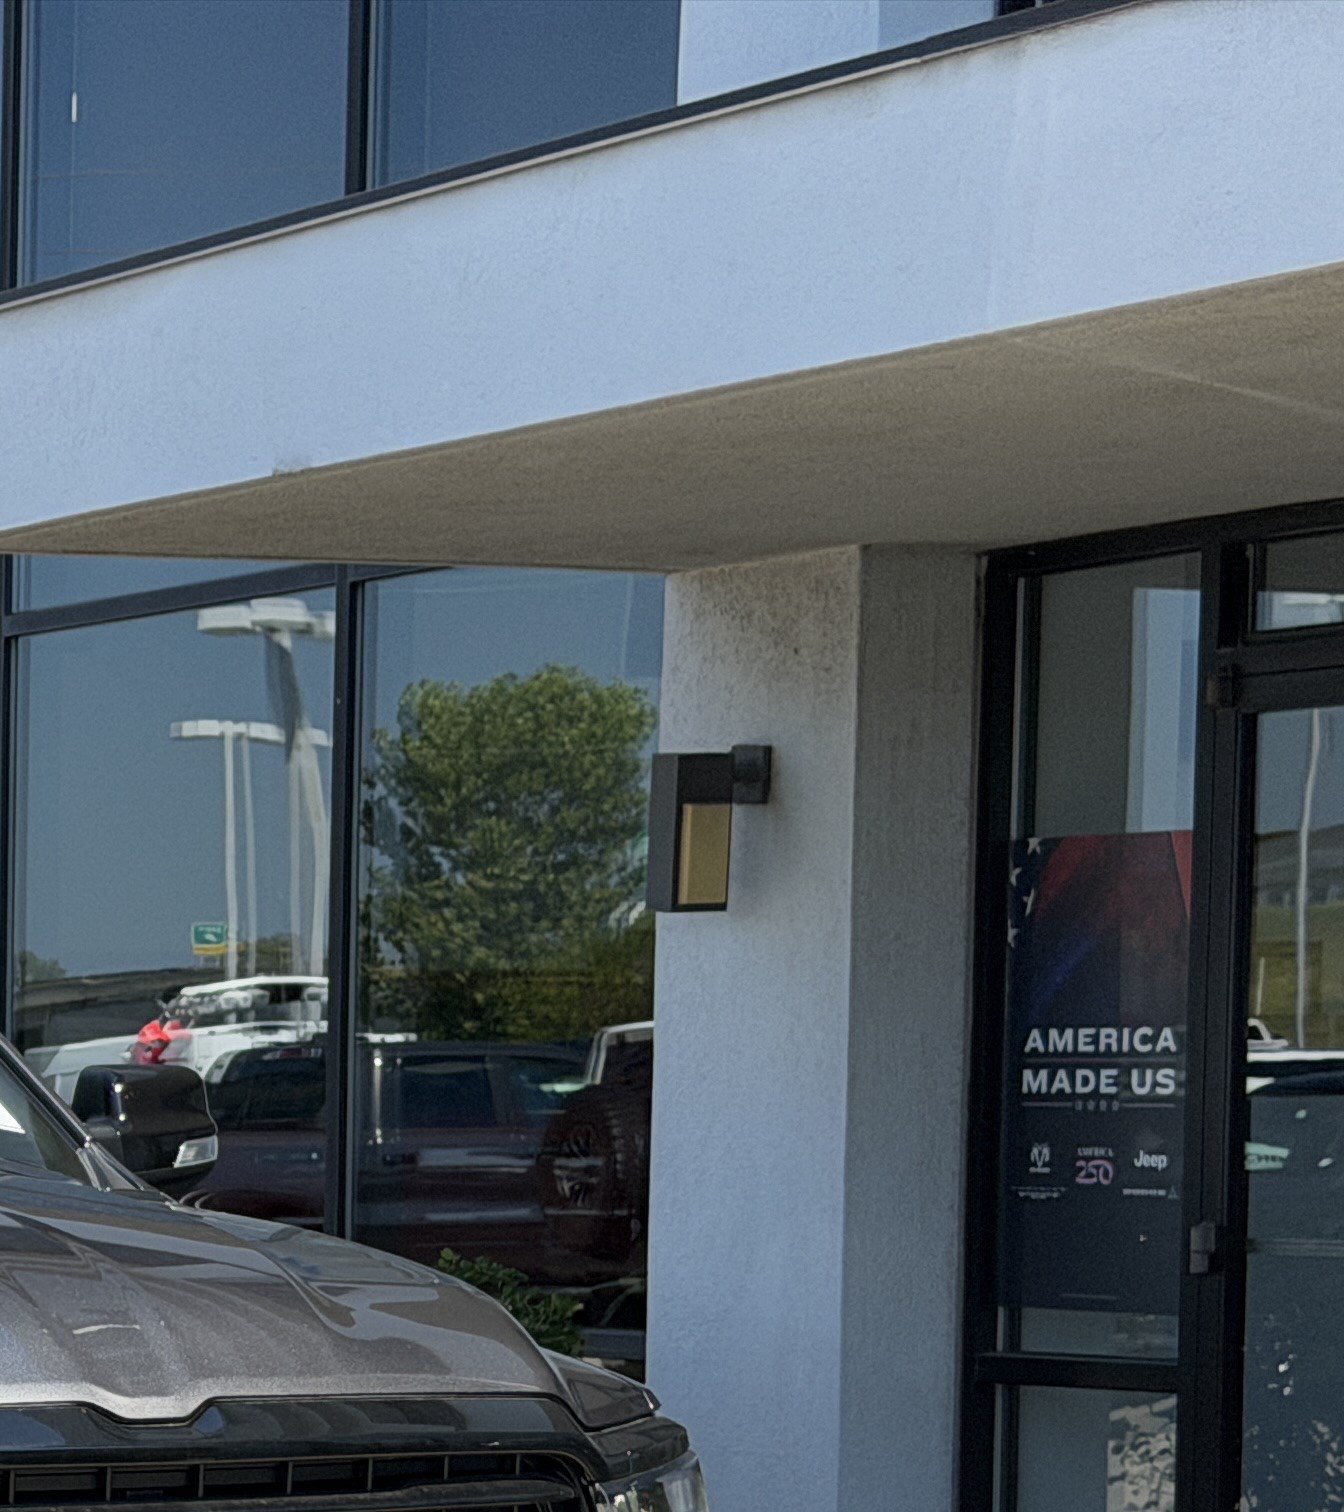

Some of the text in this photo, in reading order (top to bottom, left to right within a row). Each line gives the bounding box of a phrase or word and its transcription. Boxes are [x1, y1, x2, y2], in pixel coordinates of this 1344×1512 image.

[1024, 1026, 1176, 1053] AMERICA
[1021, 1068, 1176, 1095] MADE US
[1134, 1150, 1168, 1172] Jeep
